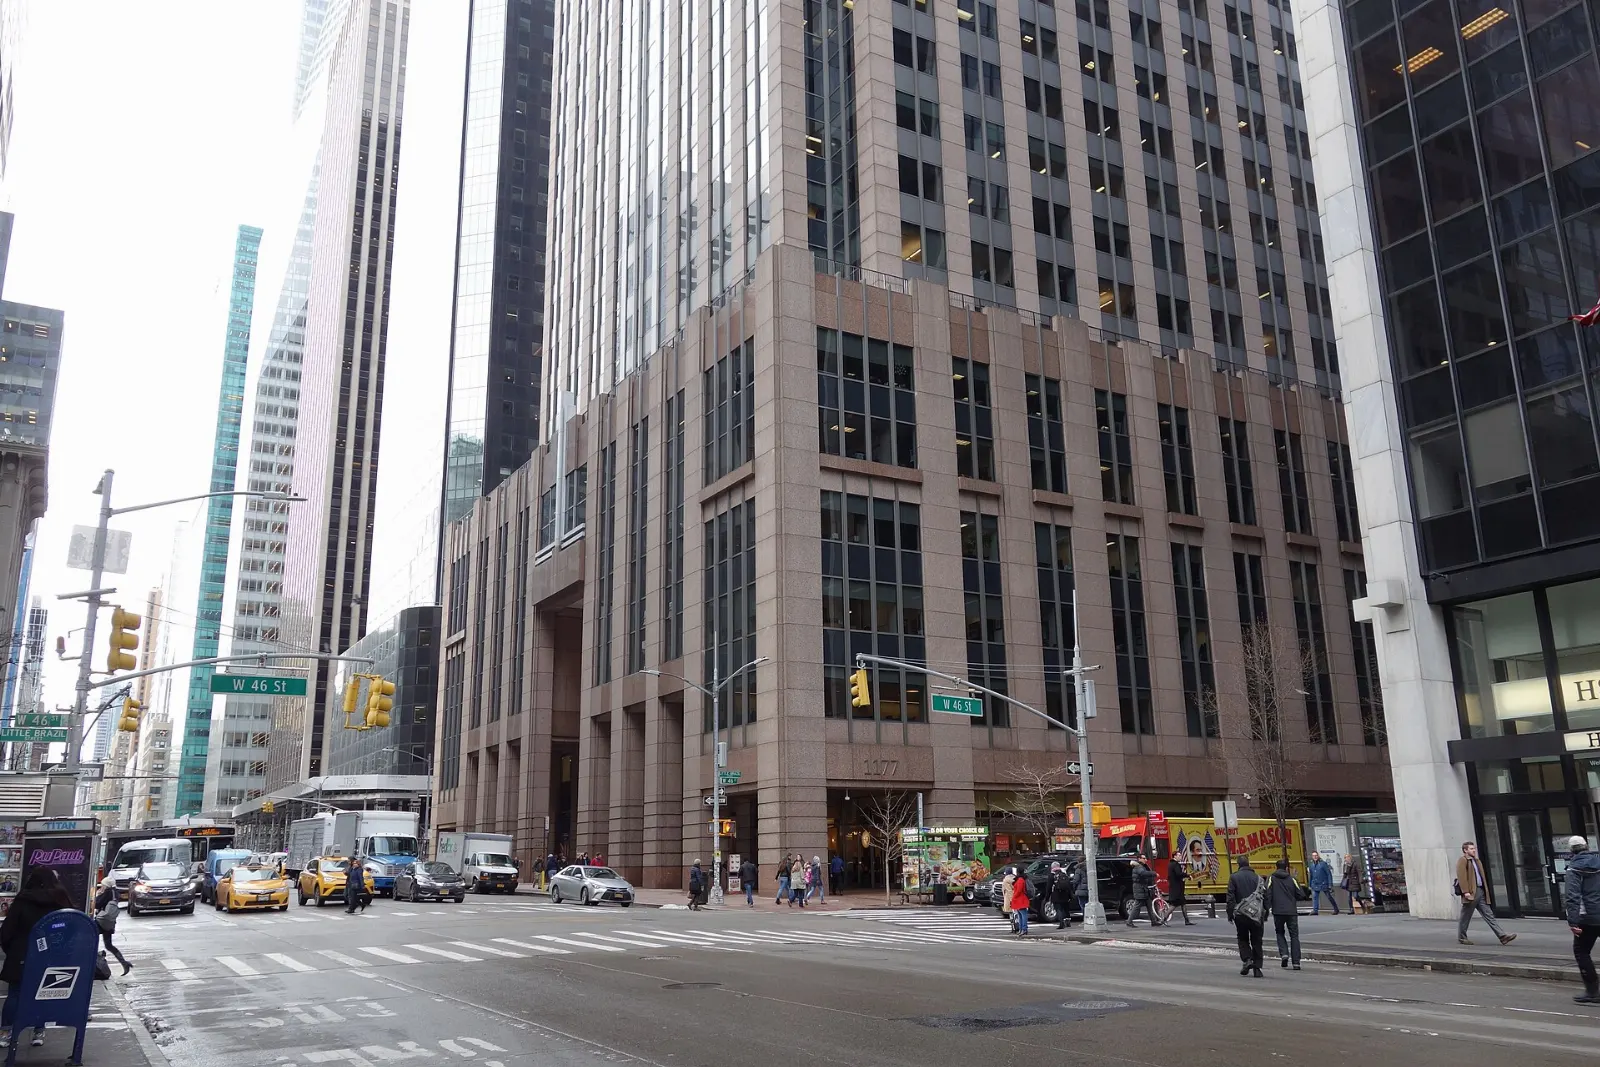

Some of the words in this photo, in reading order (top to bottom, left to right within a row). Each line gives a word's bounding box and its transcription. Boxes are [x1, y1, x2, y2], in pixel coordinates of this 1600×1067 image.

[233, 679, 245, 690] W
[251, 680, 268, 691] 46
[274, 680, 287, 692] St
[1574, 679, 1600, 701] H
[943, 699, 950, 709] W
[953, 700, 962, 711] 46
[964, 701, 972, 712] St
[17, 714, 26, 725] W
[32, 715, 48, 726] 46
[1, 729, 31, 737] LITTLE
[34, 729, 66, 738] BRAZIL
[864, 760, 898, 776] 1177
[43, 821, 77, 830] TITAN
